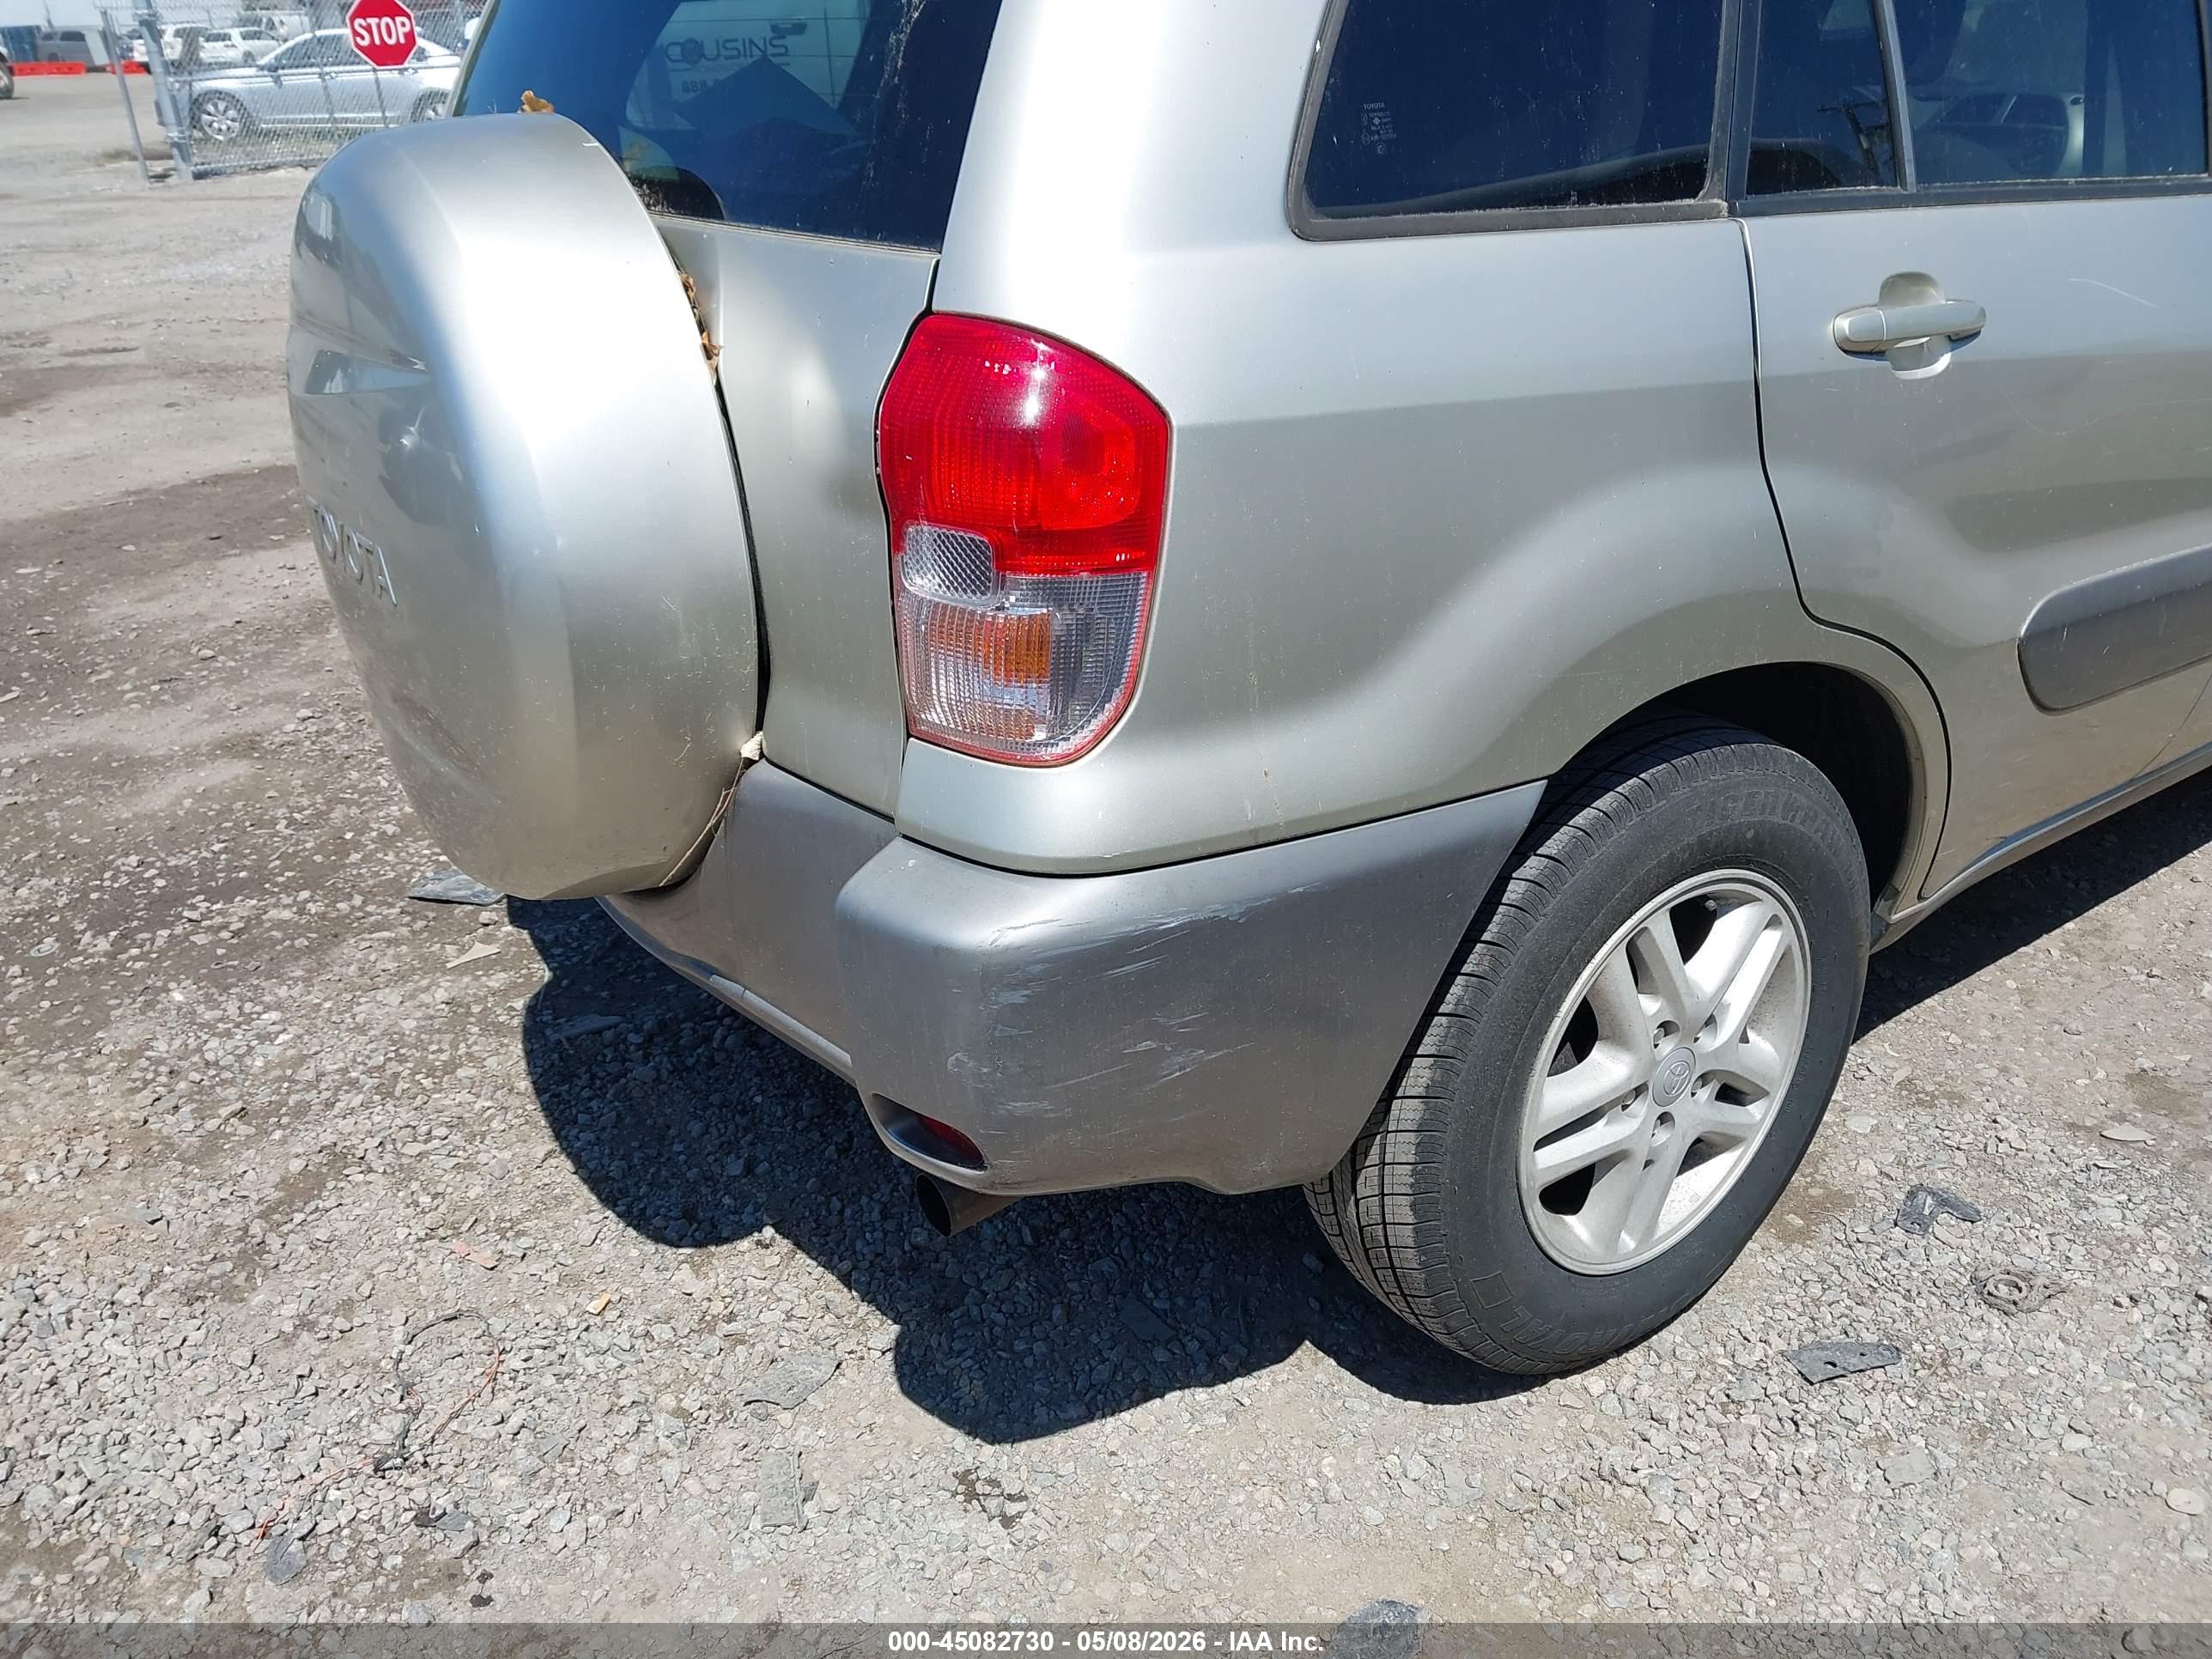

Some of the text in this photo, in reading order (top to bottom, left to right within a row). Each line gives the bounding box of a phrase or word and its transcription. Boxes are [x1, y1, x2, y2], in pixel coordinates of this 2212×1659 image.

[353, 15, 411, 47] STOP
[665, 35, 789, 65] COUSINS
[305, 495, 398, 607] TOYOTA
